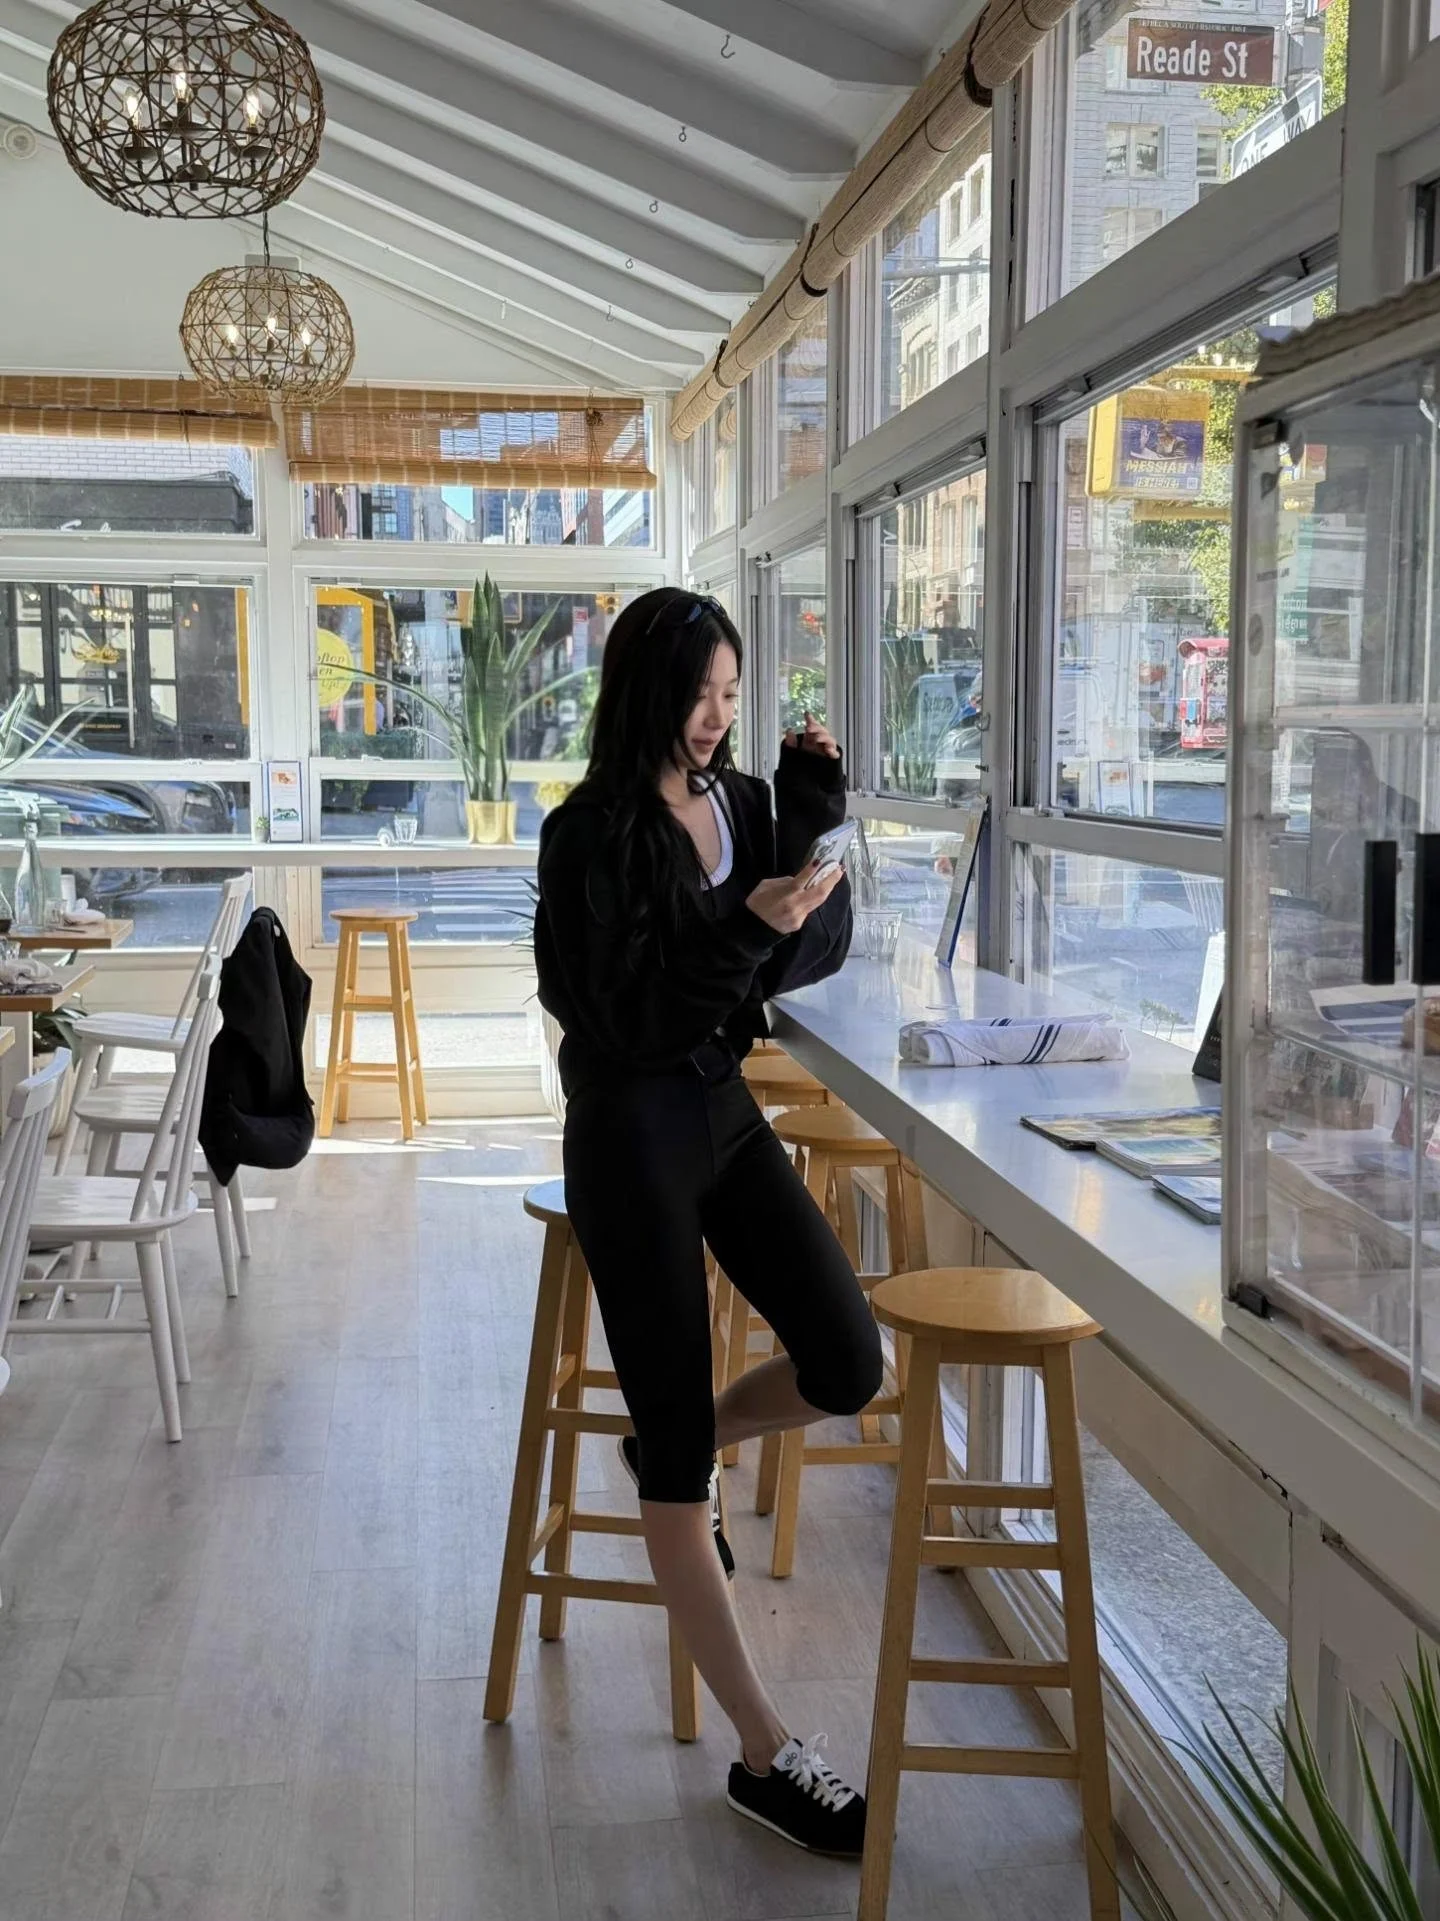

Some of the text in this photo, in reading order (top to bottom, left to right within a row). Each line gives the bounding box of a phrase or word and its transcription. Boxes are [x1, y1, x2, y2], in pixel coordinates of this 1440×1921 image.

[1136, 36, 1249, 79] Reade St
[1126, 459, 1187, 474] MESSIAH
